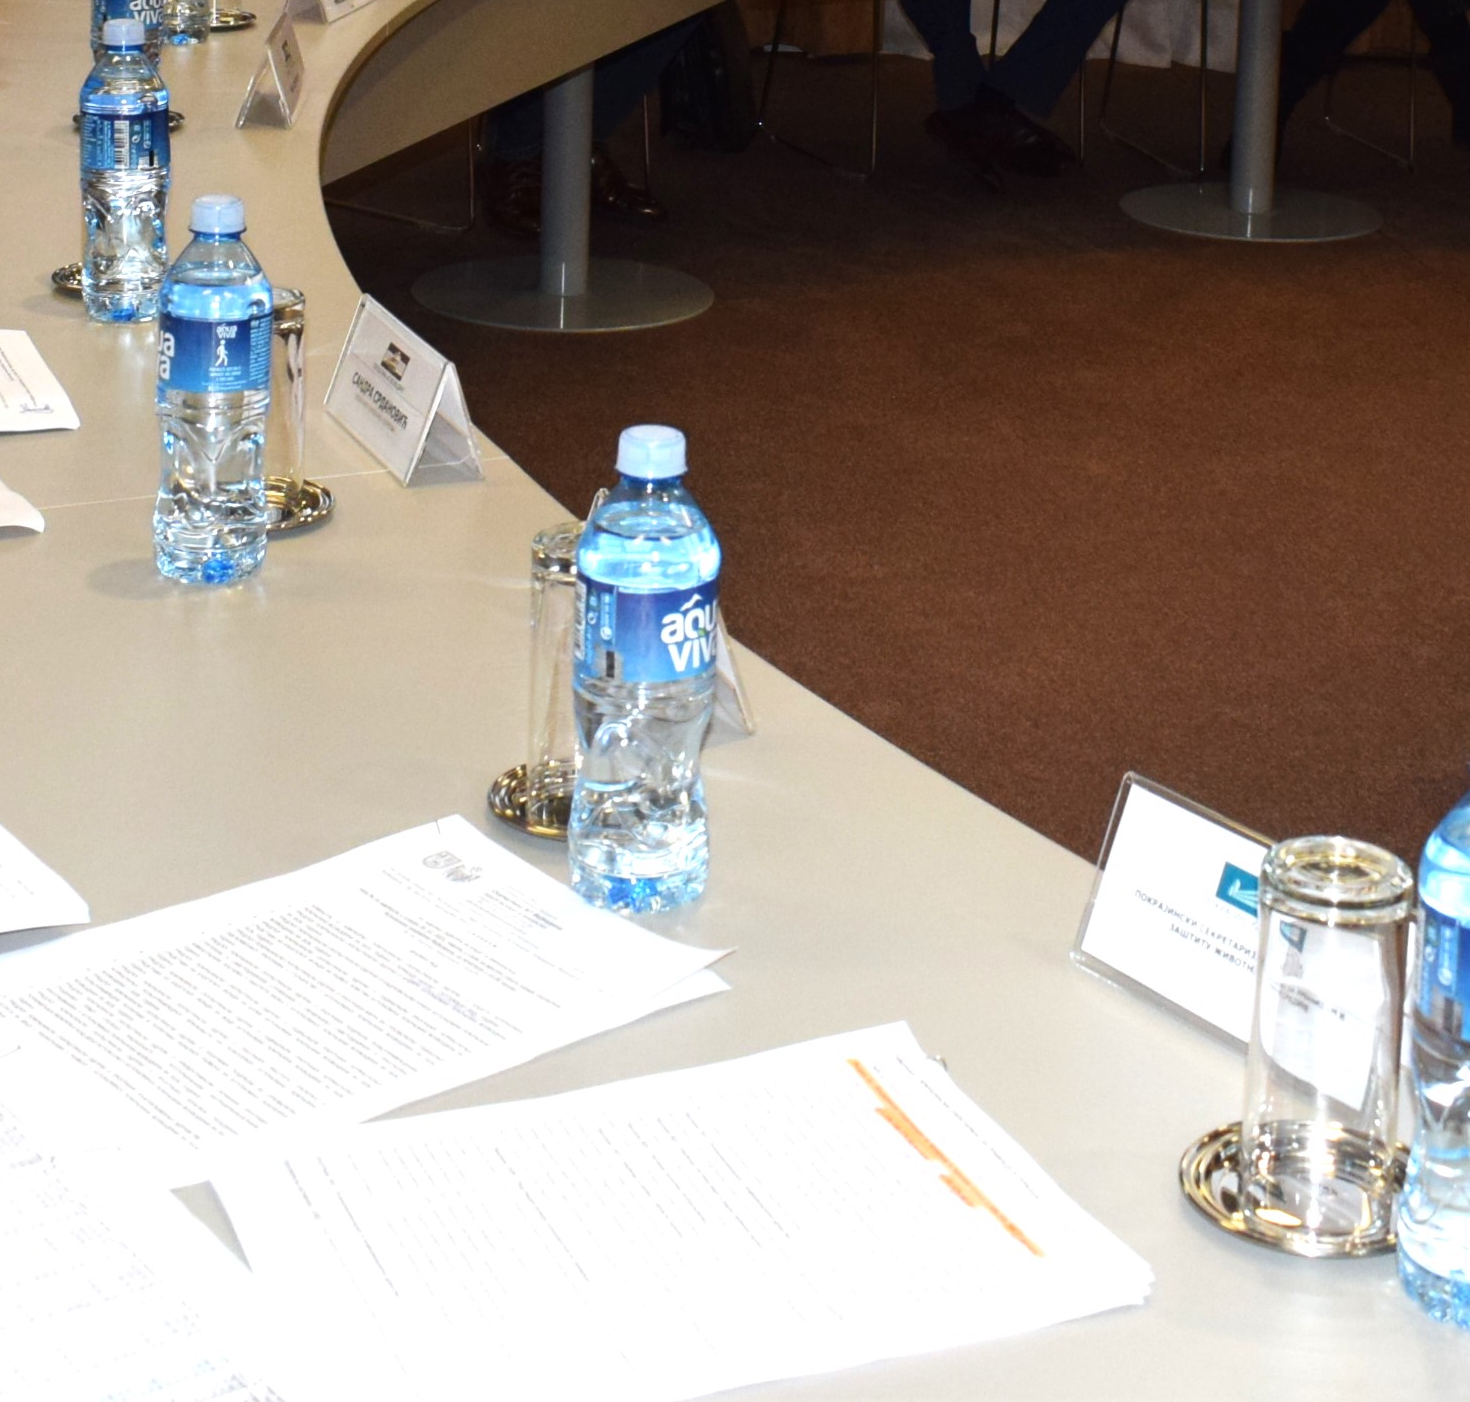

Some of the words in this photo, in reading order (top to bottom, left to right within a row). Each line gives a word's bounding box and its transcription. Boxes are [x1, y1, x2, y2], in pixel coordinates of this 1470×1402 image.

[661, 594, 717, 644] aqu
[1135, 889, 1197, 927] ПОКРАЈИНСКИ
[1200, 924, 1257, 959] СЕКРЕТАРИЈ
[1170, 923, 1211, 950] ЗАШТИТУ
[1215, 947, 1256, 973] ЖИВОТН
